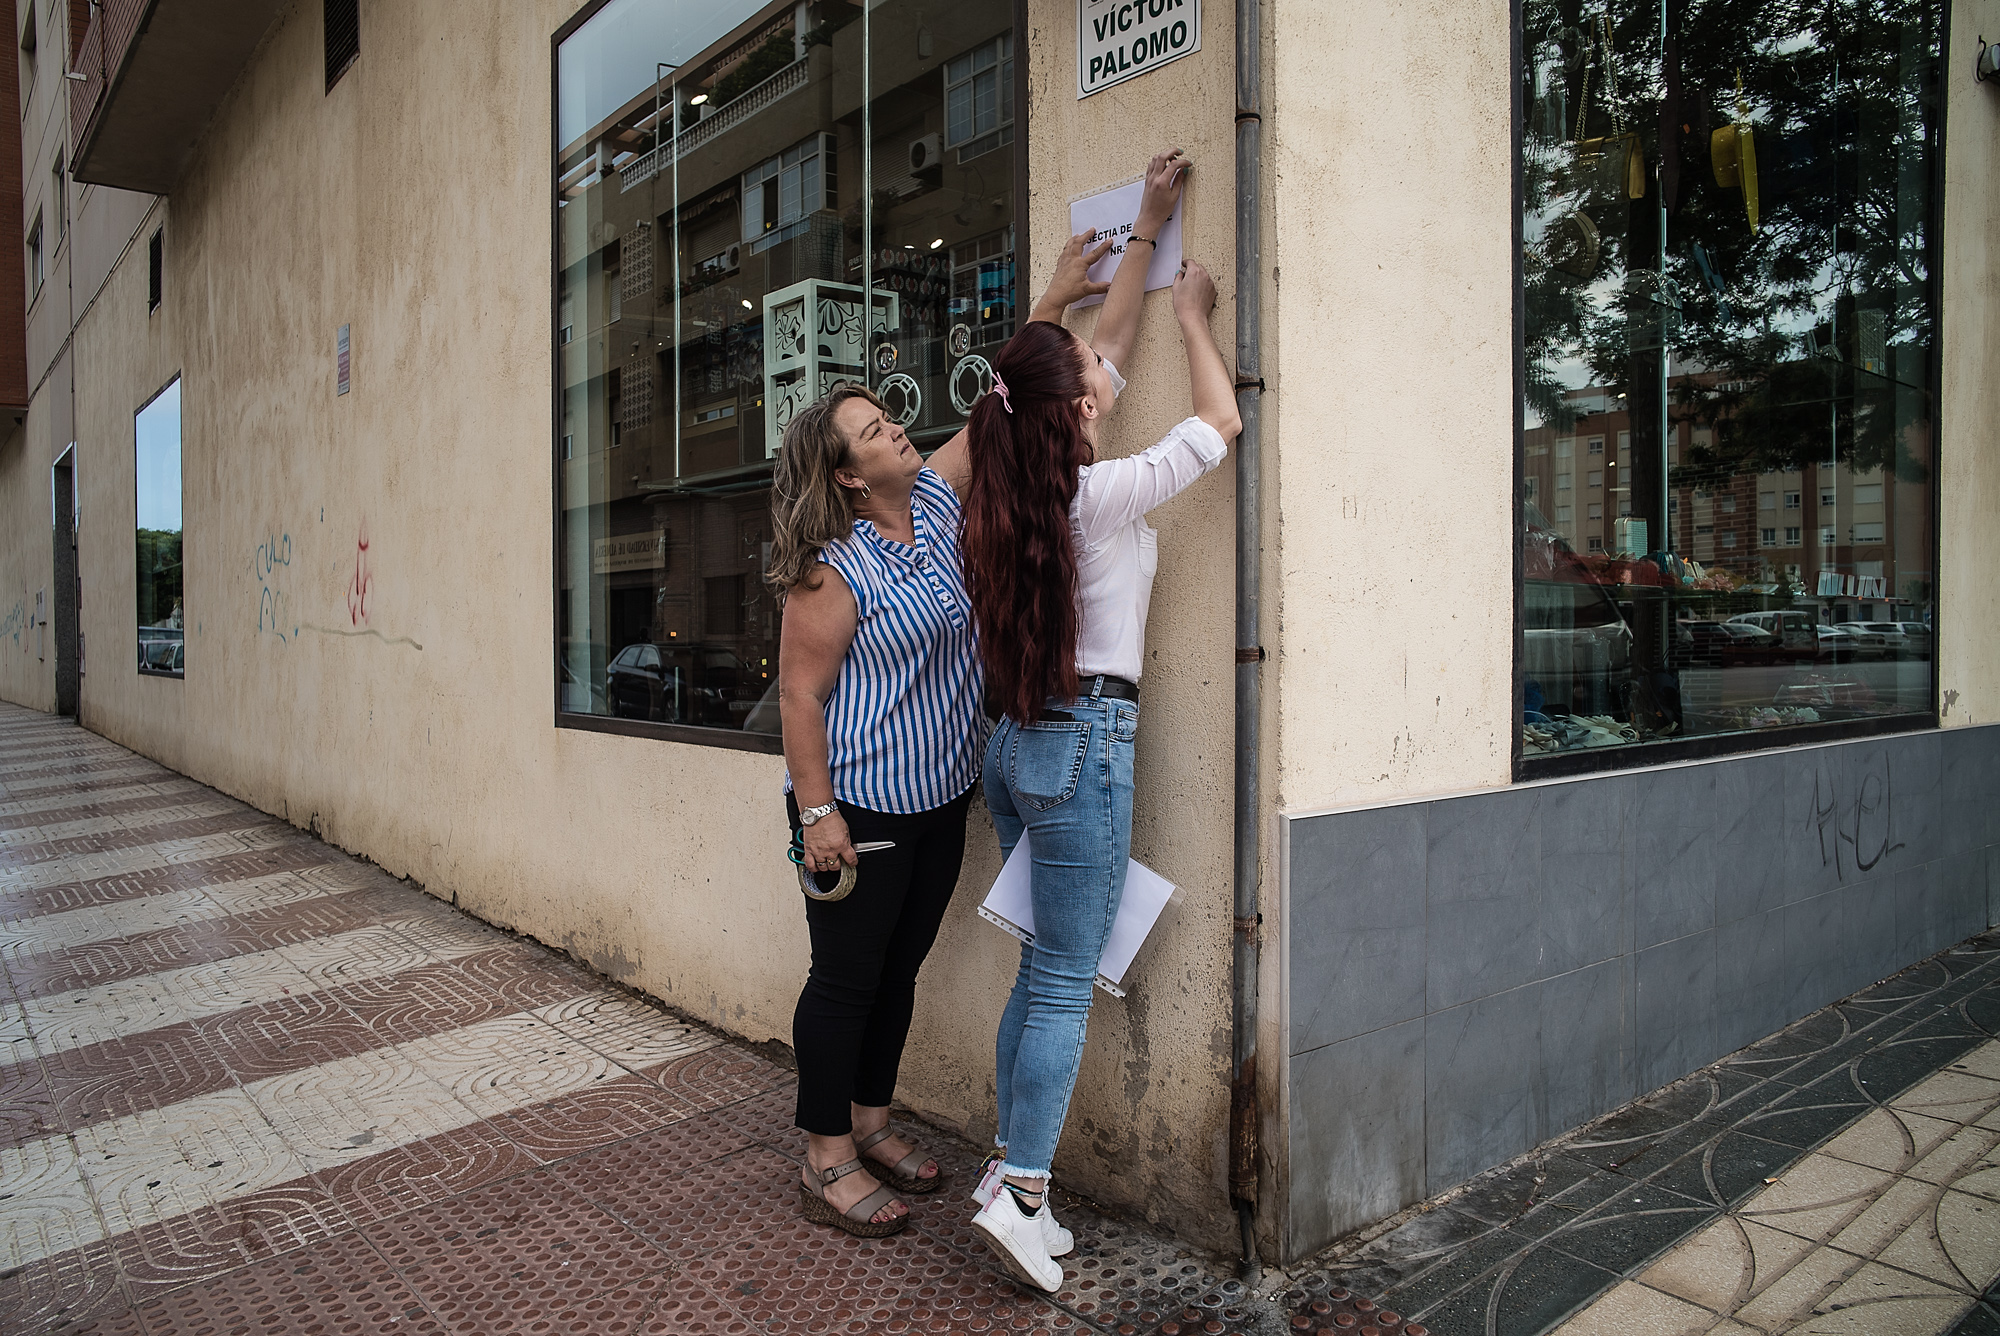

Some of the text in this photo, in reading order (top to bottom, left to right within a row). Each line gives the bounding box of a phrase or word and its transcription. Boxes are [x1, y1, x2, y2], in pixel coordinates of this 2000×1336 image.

[1090, 20, 1187, 84] PALOMO
[1120, 223, 1133, 235] DE
[256, 533, 292, 582] CULO
